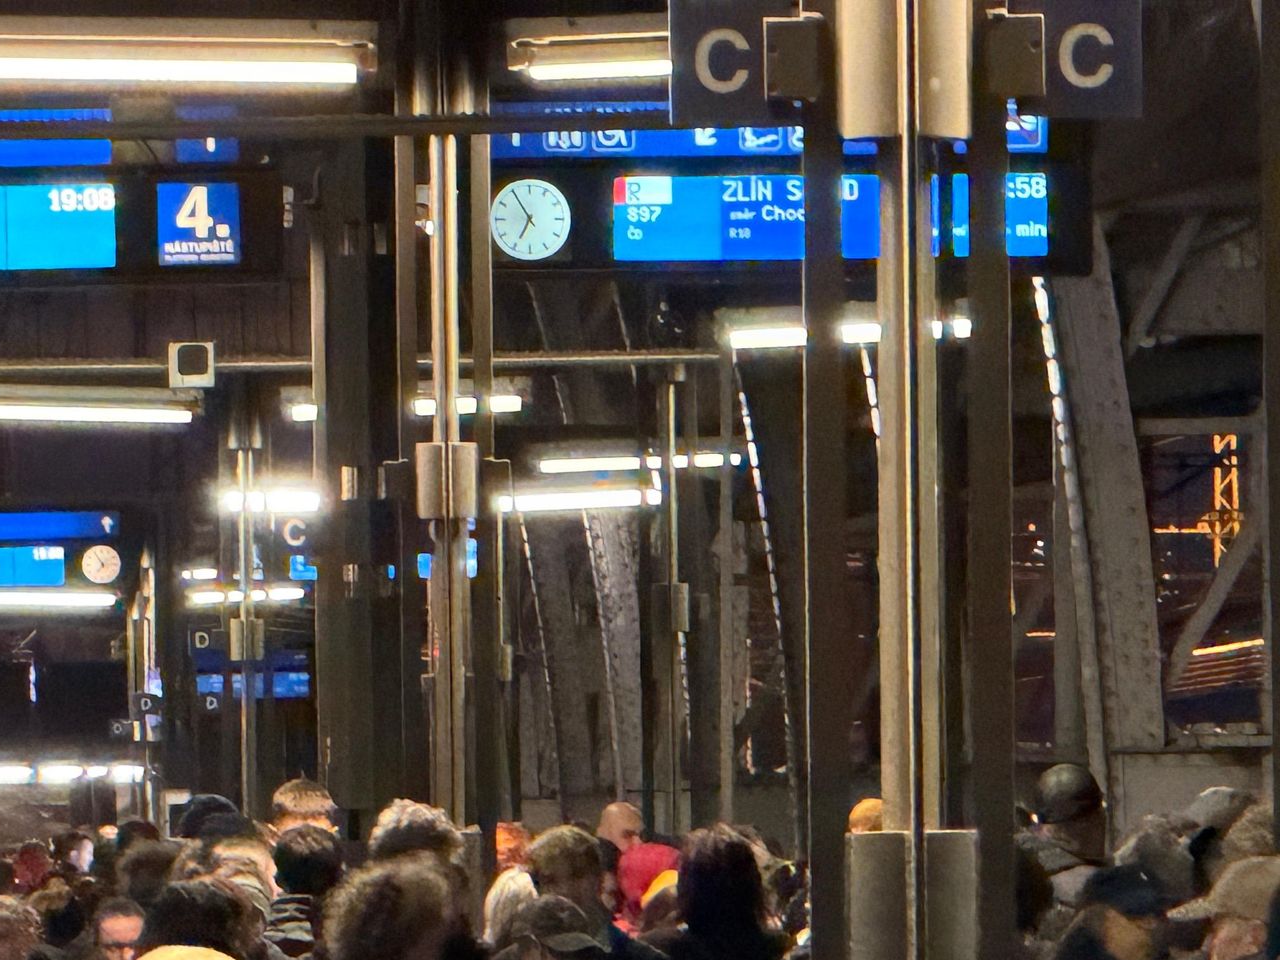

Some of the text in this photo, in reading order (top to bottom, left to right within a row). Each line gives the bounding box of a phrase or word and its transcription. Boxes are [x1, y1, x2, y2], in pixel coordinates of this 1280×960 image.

[695, 28, 750, 93] C
[1058, 23, 1114, 88] C
[48, 188, 116, 212] 19:08
[627, 182, 641, 201] R
[283, 519, 306, 546] C
[195, 631, 210, 648] D
